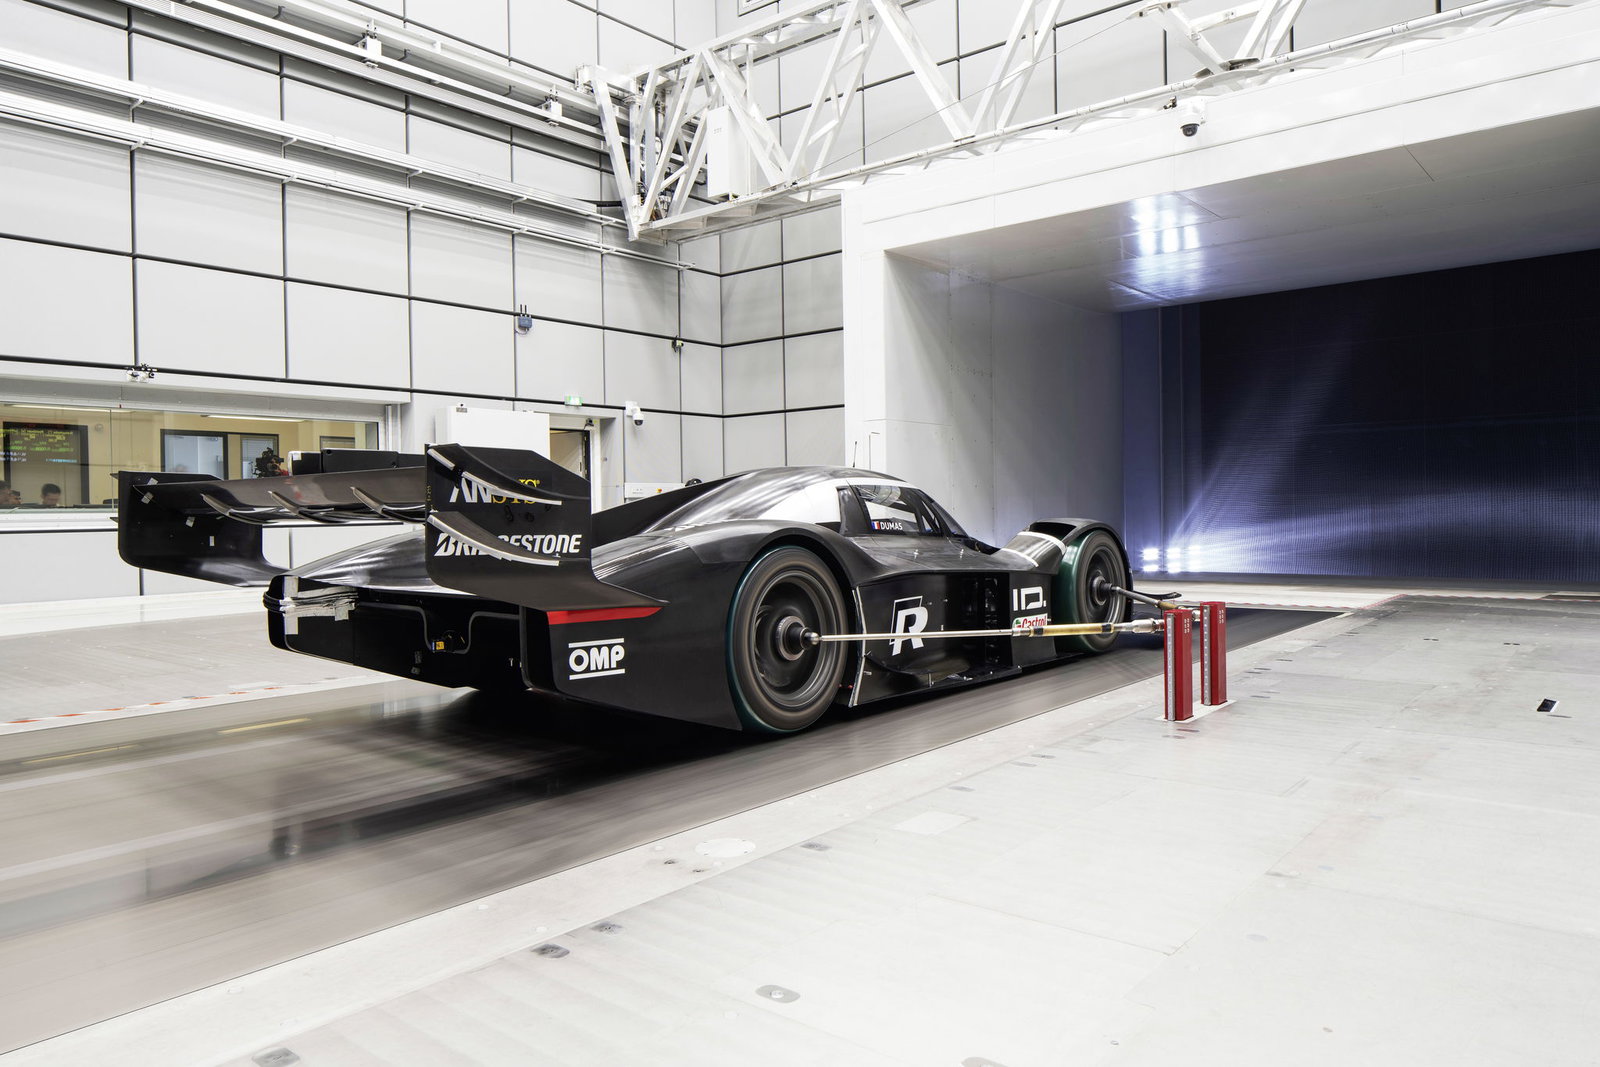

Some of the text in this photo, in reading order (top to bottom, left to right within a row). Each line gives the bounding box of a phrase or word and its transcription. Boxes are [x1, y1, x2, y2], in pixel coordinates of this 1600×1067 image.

[880, 521, 903, 531] DUMAS
[890, 604, 928, 656] R
[568, 644, 625, 673] OMP
